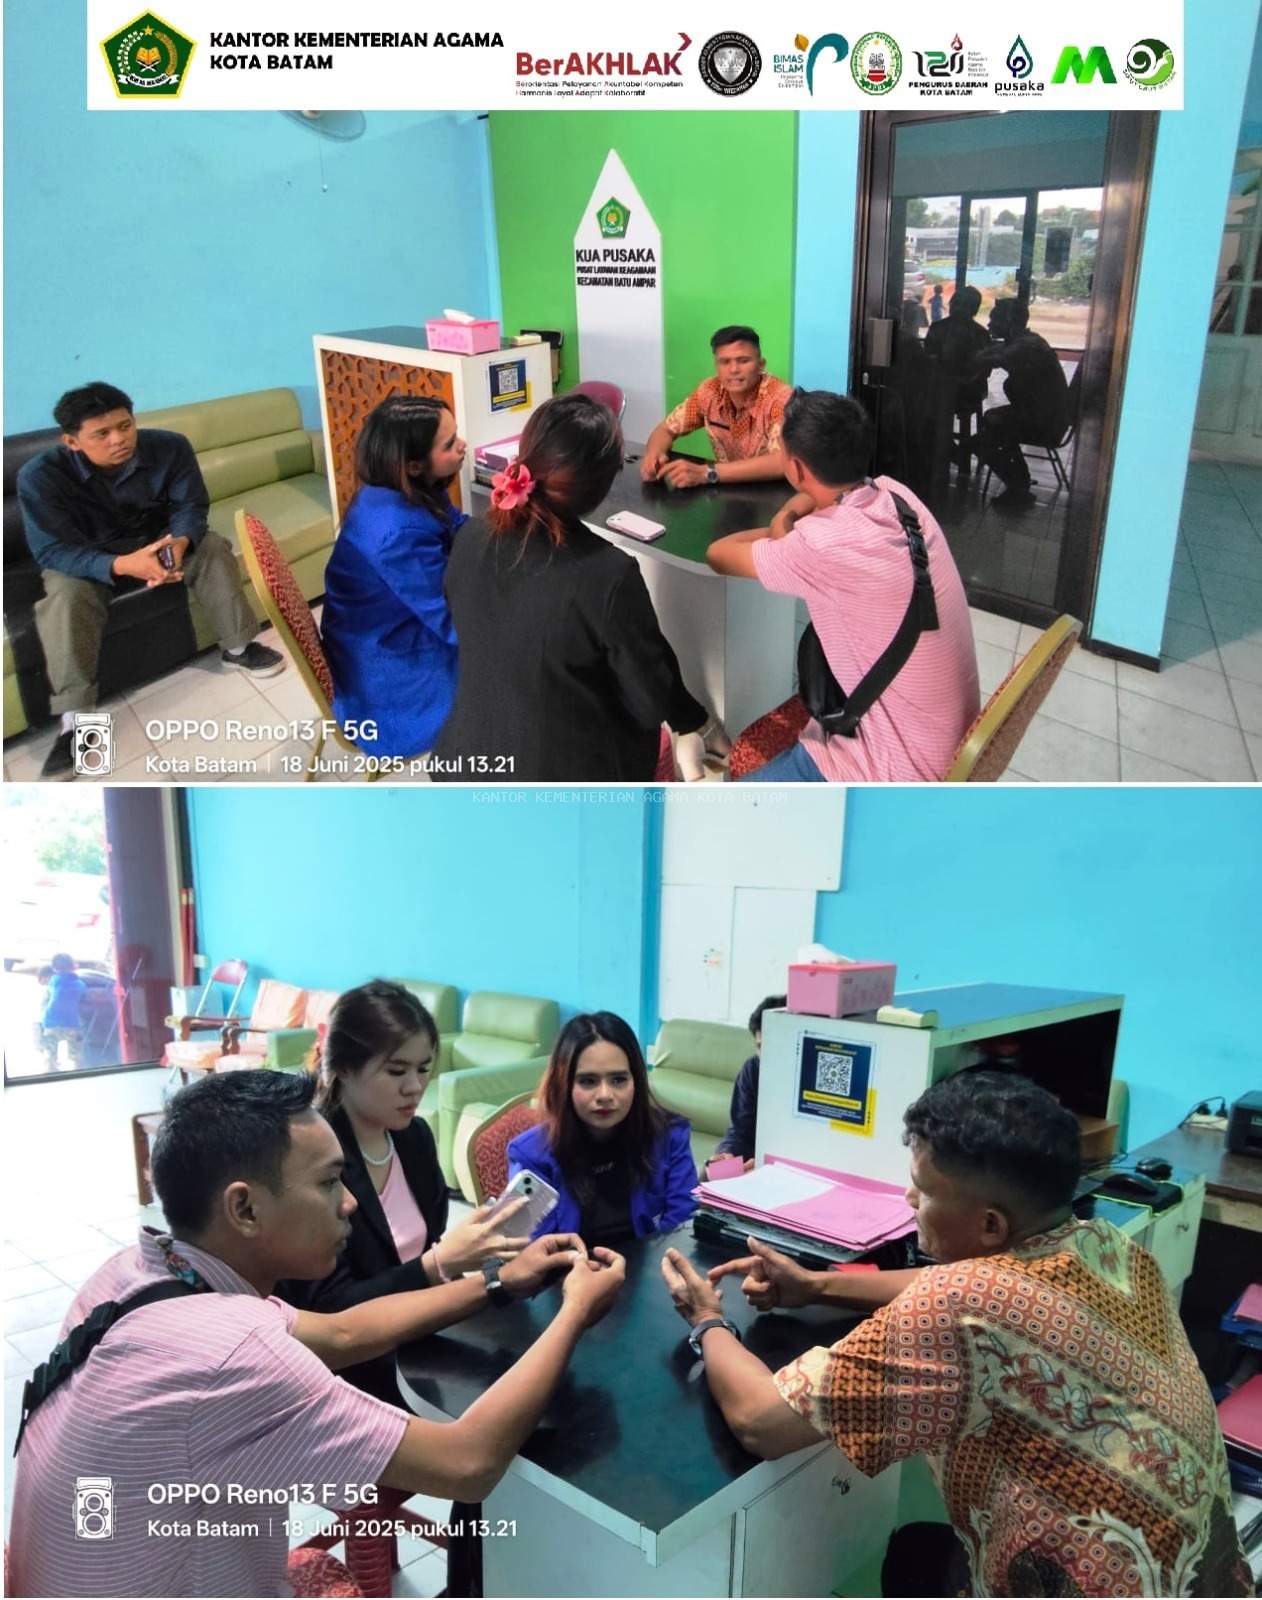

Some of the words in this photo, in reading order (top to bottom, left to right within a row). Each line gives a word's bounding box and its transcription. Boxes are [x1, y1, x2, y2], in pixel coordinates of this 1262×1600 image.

[575, 249, 600, 263] KUA
[603, 248, 656, 262] PUSAKA
[620, 266, 656, 275] KEAGAMAAN
[577, 277, 613, 286] KECAMATAN
[614, 277, 631, 287] BATU
[632, 277, 656, 288] AMPAR
